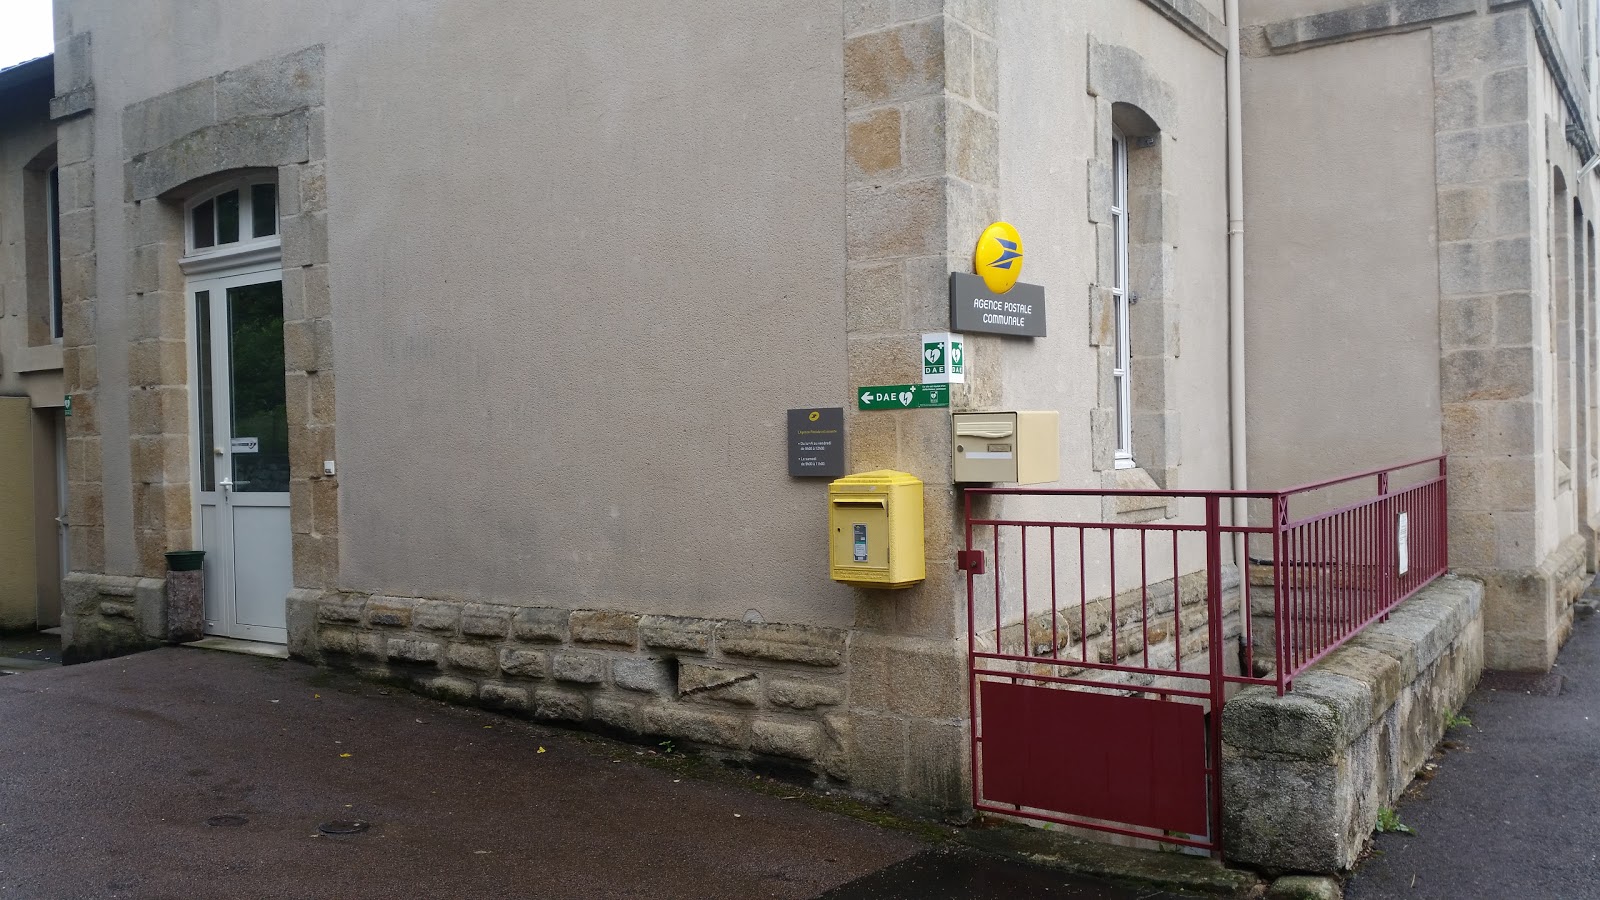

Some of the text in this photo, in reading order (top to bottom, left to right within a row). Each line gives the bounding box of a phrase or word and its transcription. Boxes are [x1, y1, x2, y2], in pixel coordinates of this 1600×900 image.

[973, 298, 1032, 314] AGENCE POSTALE
[982, 313, 1025, 327] COMMUNALE
[925, 366, 944, 374] DAE
[876, 392, 897, 401] DAE
